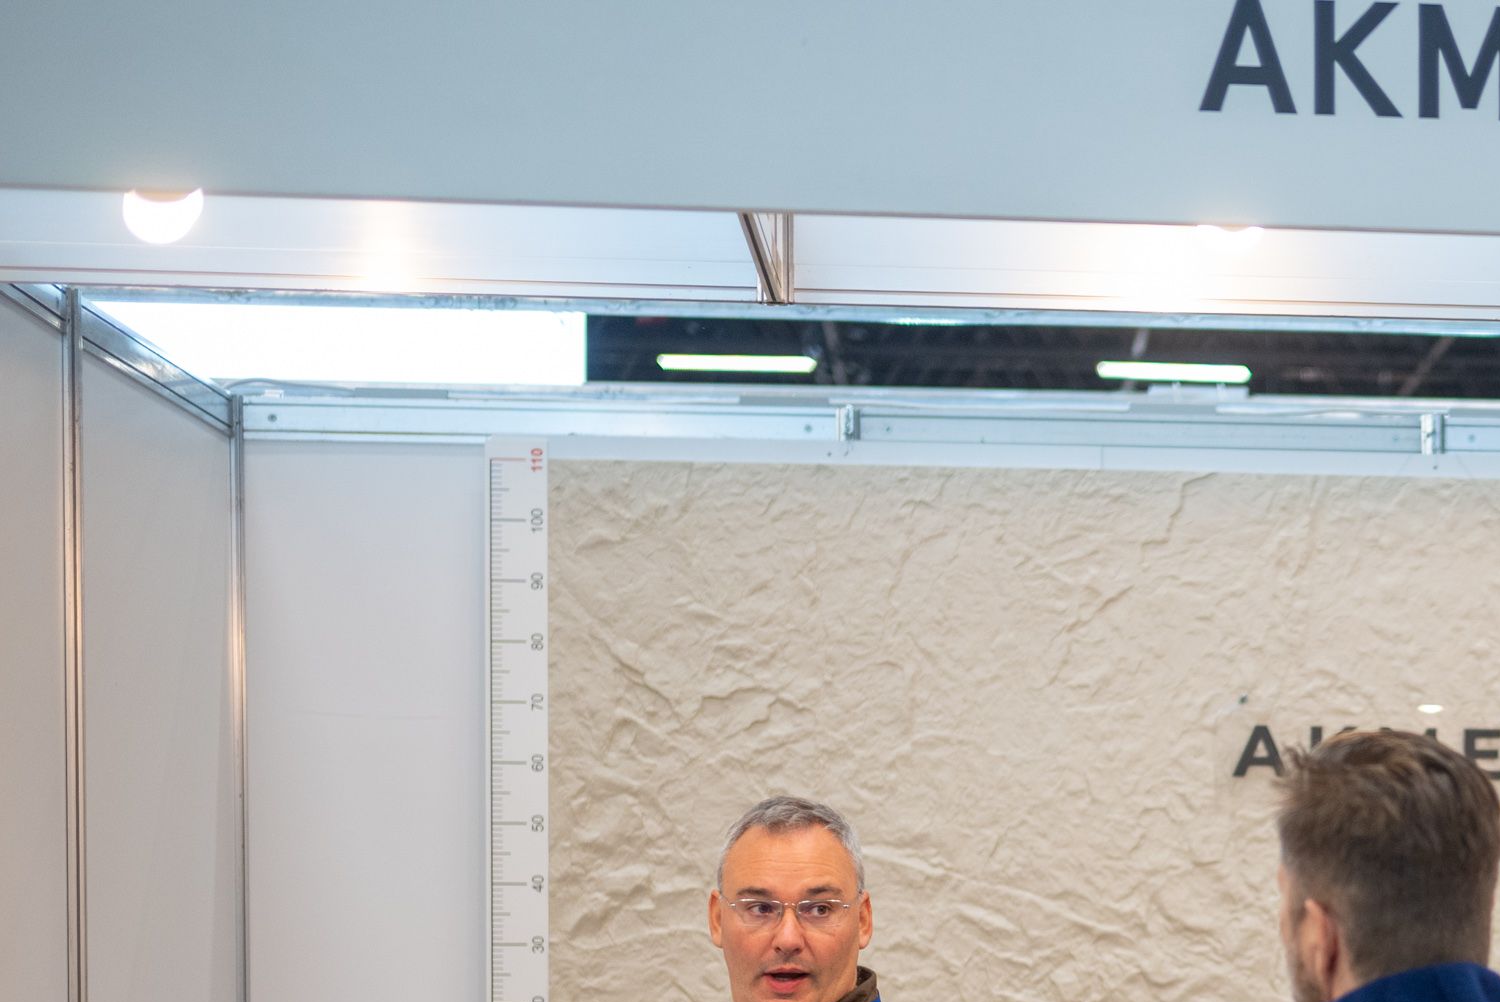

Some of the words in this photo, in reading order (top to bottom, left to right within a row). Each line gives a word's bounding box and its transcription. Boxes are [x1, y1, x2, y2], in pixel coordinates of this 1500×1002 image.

[530, 447, 544, 472] 110
[531, 508, 544, 533] 100
[531, 572, 544, 590] 90
[531, 633, 544, 651] 80
[531, 694, 544, 711] 70
[532, 754, 545, 772] 60
[532, 814, 545, 833] 50
[532, 875, 545, 893] 40
[532, 935, 545, 954] 30
